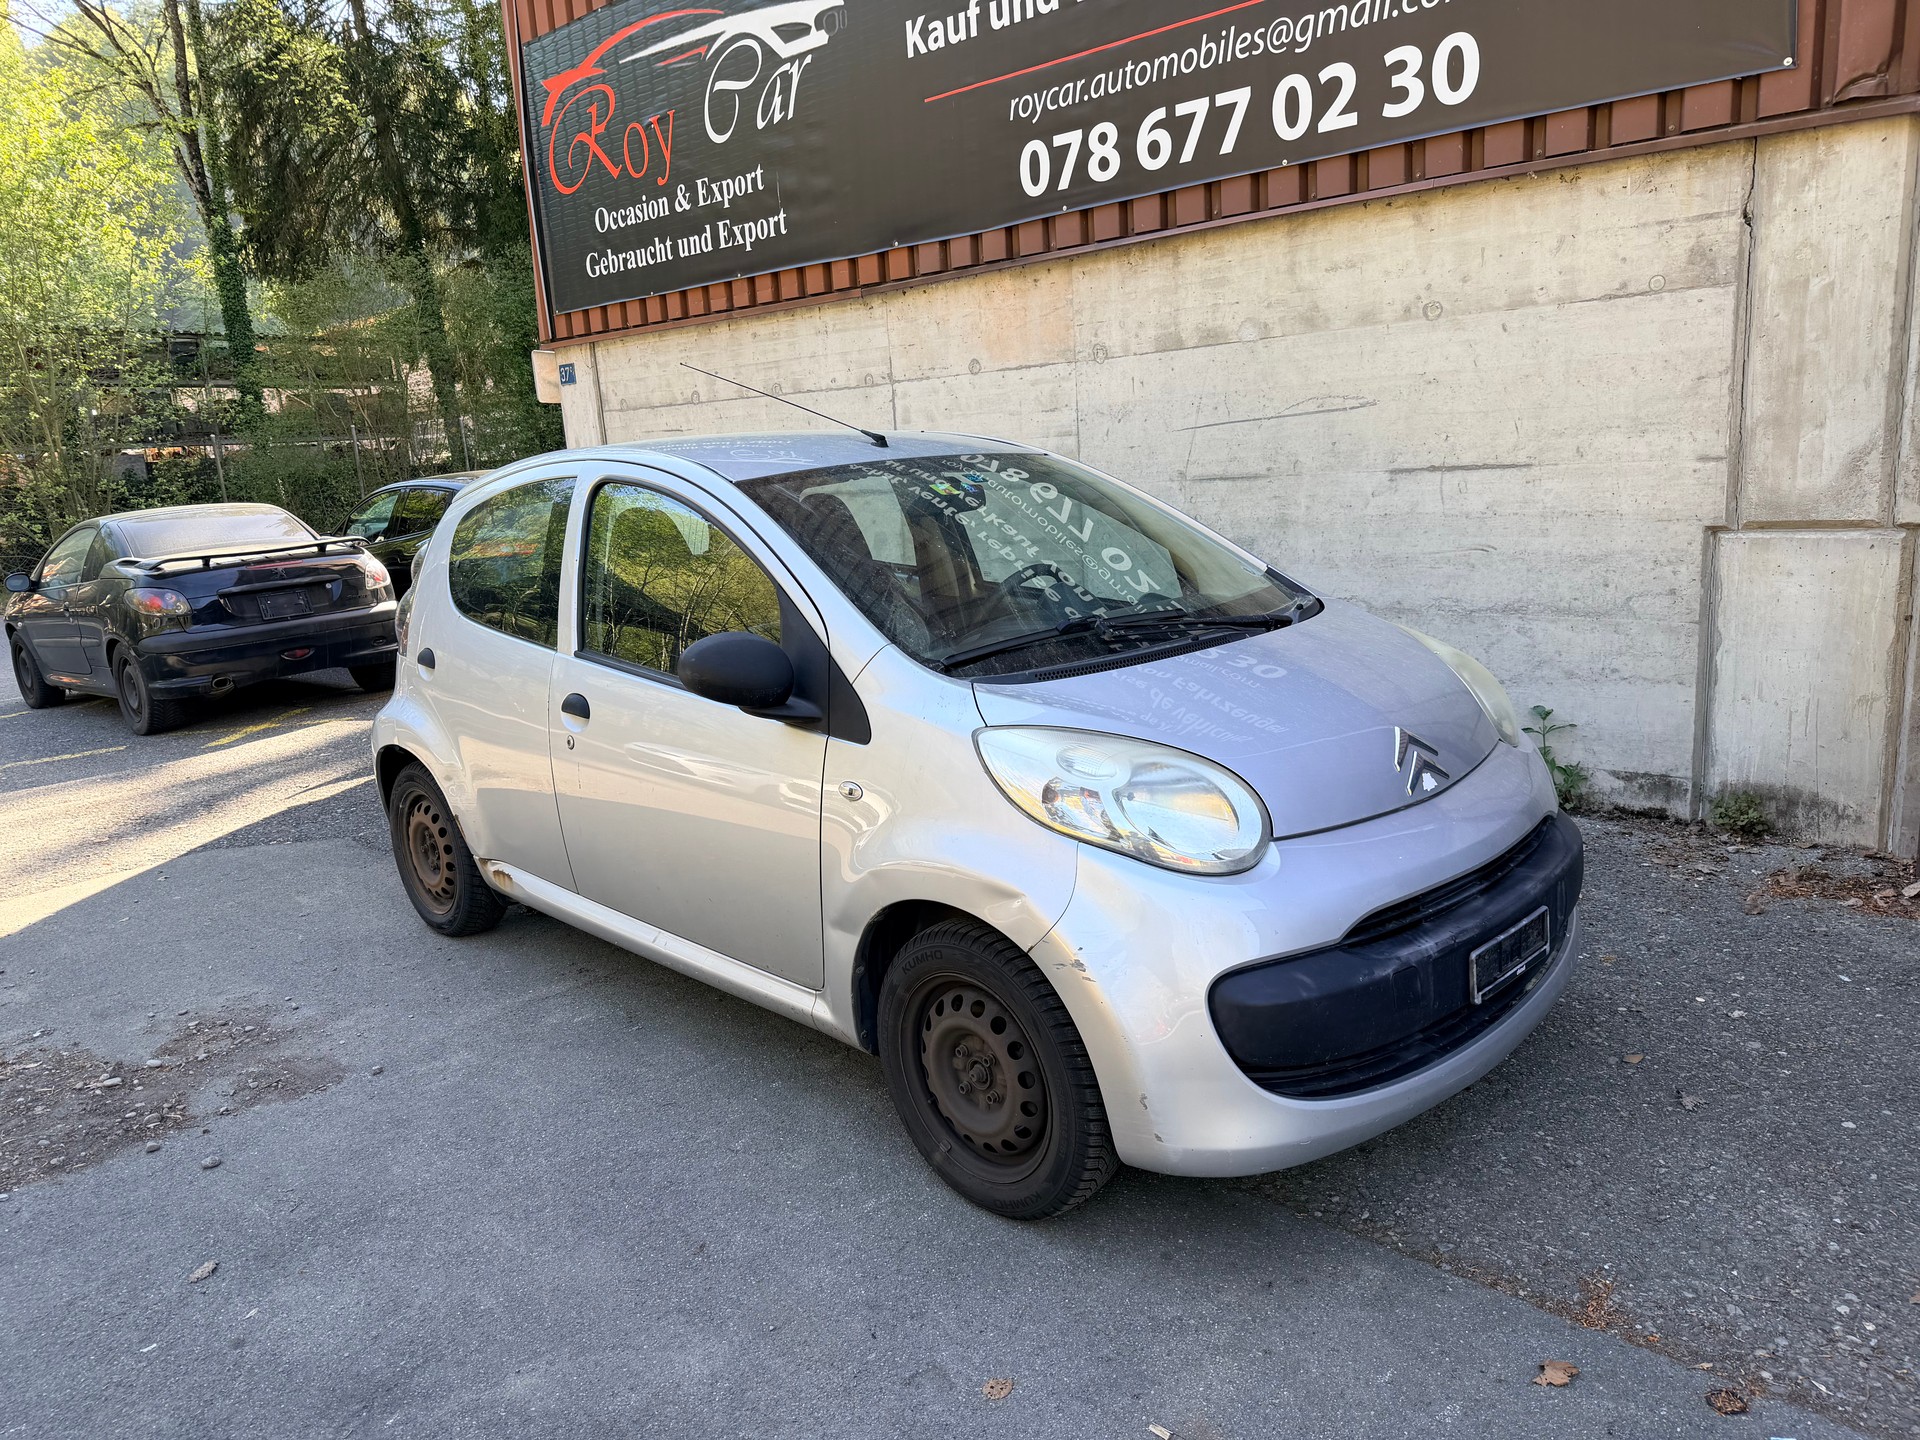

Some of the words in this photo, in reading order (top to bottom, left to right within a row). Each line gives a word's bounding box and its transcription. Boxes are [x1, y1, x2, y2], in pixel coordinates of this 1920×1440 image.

[905, 0, 980, 58] Kauf
[548, 83, 675, 195] Roy
[704, 38, 813, 144] Car
[1020, 122, 1120, 197] 078
[1136, 87, 1253, 171] 677
[1272, 61, 1357, 142] 02
[1382, 31, 1480, 118] 30
[595, 194, 669, 234] Occasion
[674, 183, 691, 212] &
[696, 164, 765, 209] Export
[585, 232, 672, 279] Gebraucht
[677, 226, 713, 259] und
[718, 208, 788, 252] Export
[901, 949, 943, 975] KUMHO
